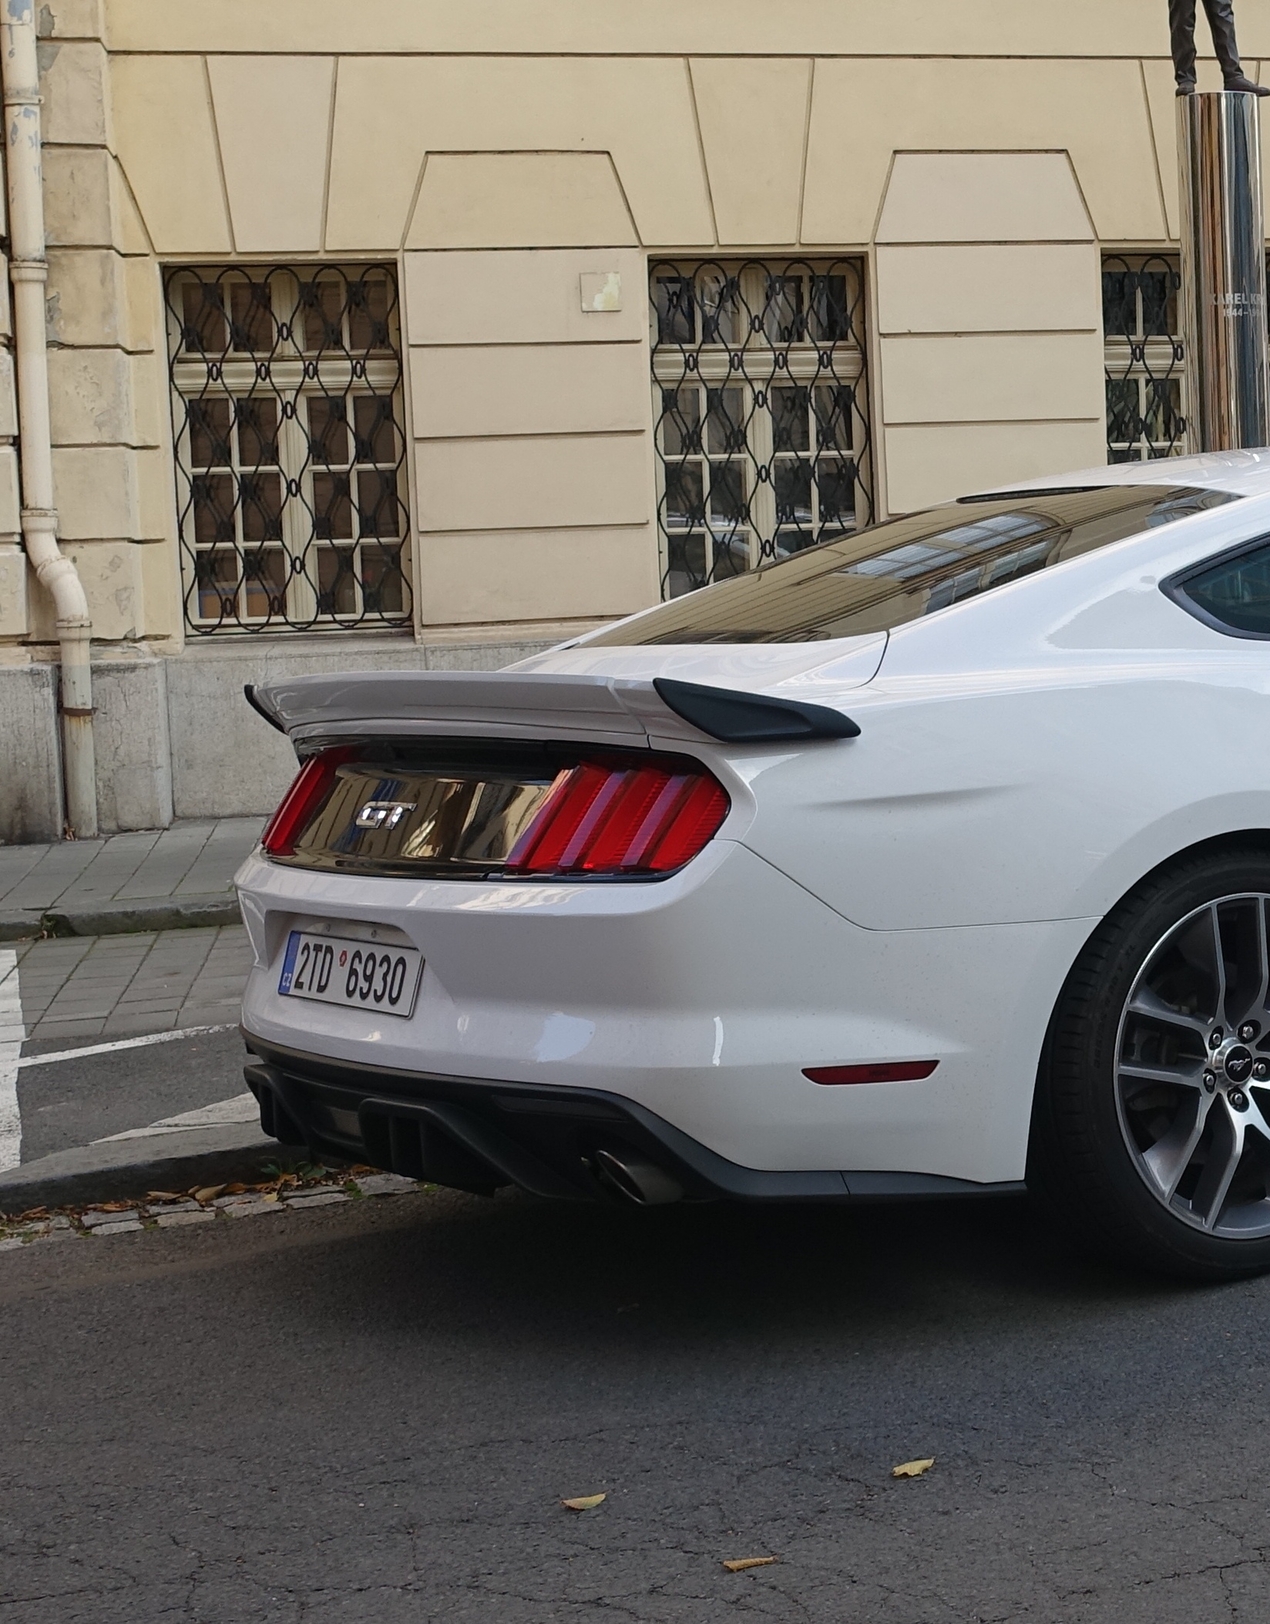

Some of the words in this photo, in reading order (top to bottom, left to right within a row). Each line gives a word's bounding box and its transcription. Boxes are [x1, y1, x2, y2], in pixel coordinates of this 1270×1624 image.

[1210, 293, 1249, 305] KAREL
[356, 801, 418, 830] GT
[282, 972, 292, 987] CZ
[294, 942, 334, 993] 2TD
[346, 950, 407, 1006] 6930
